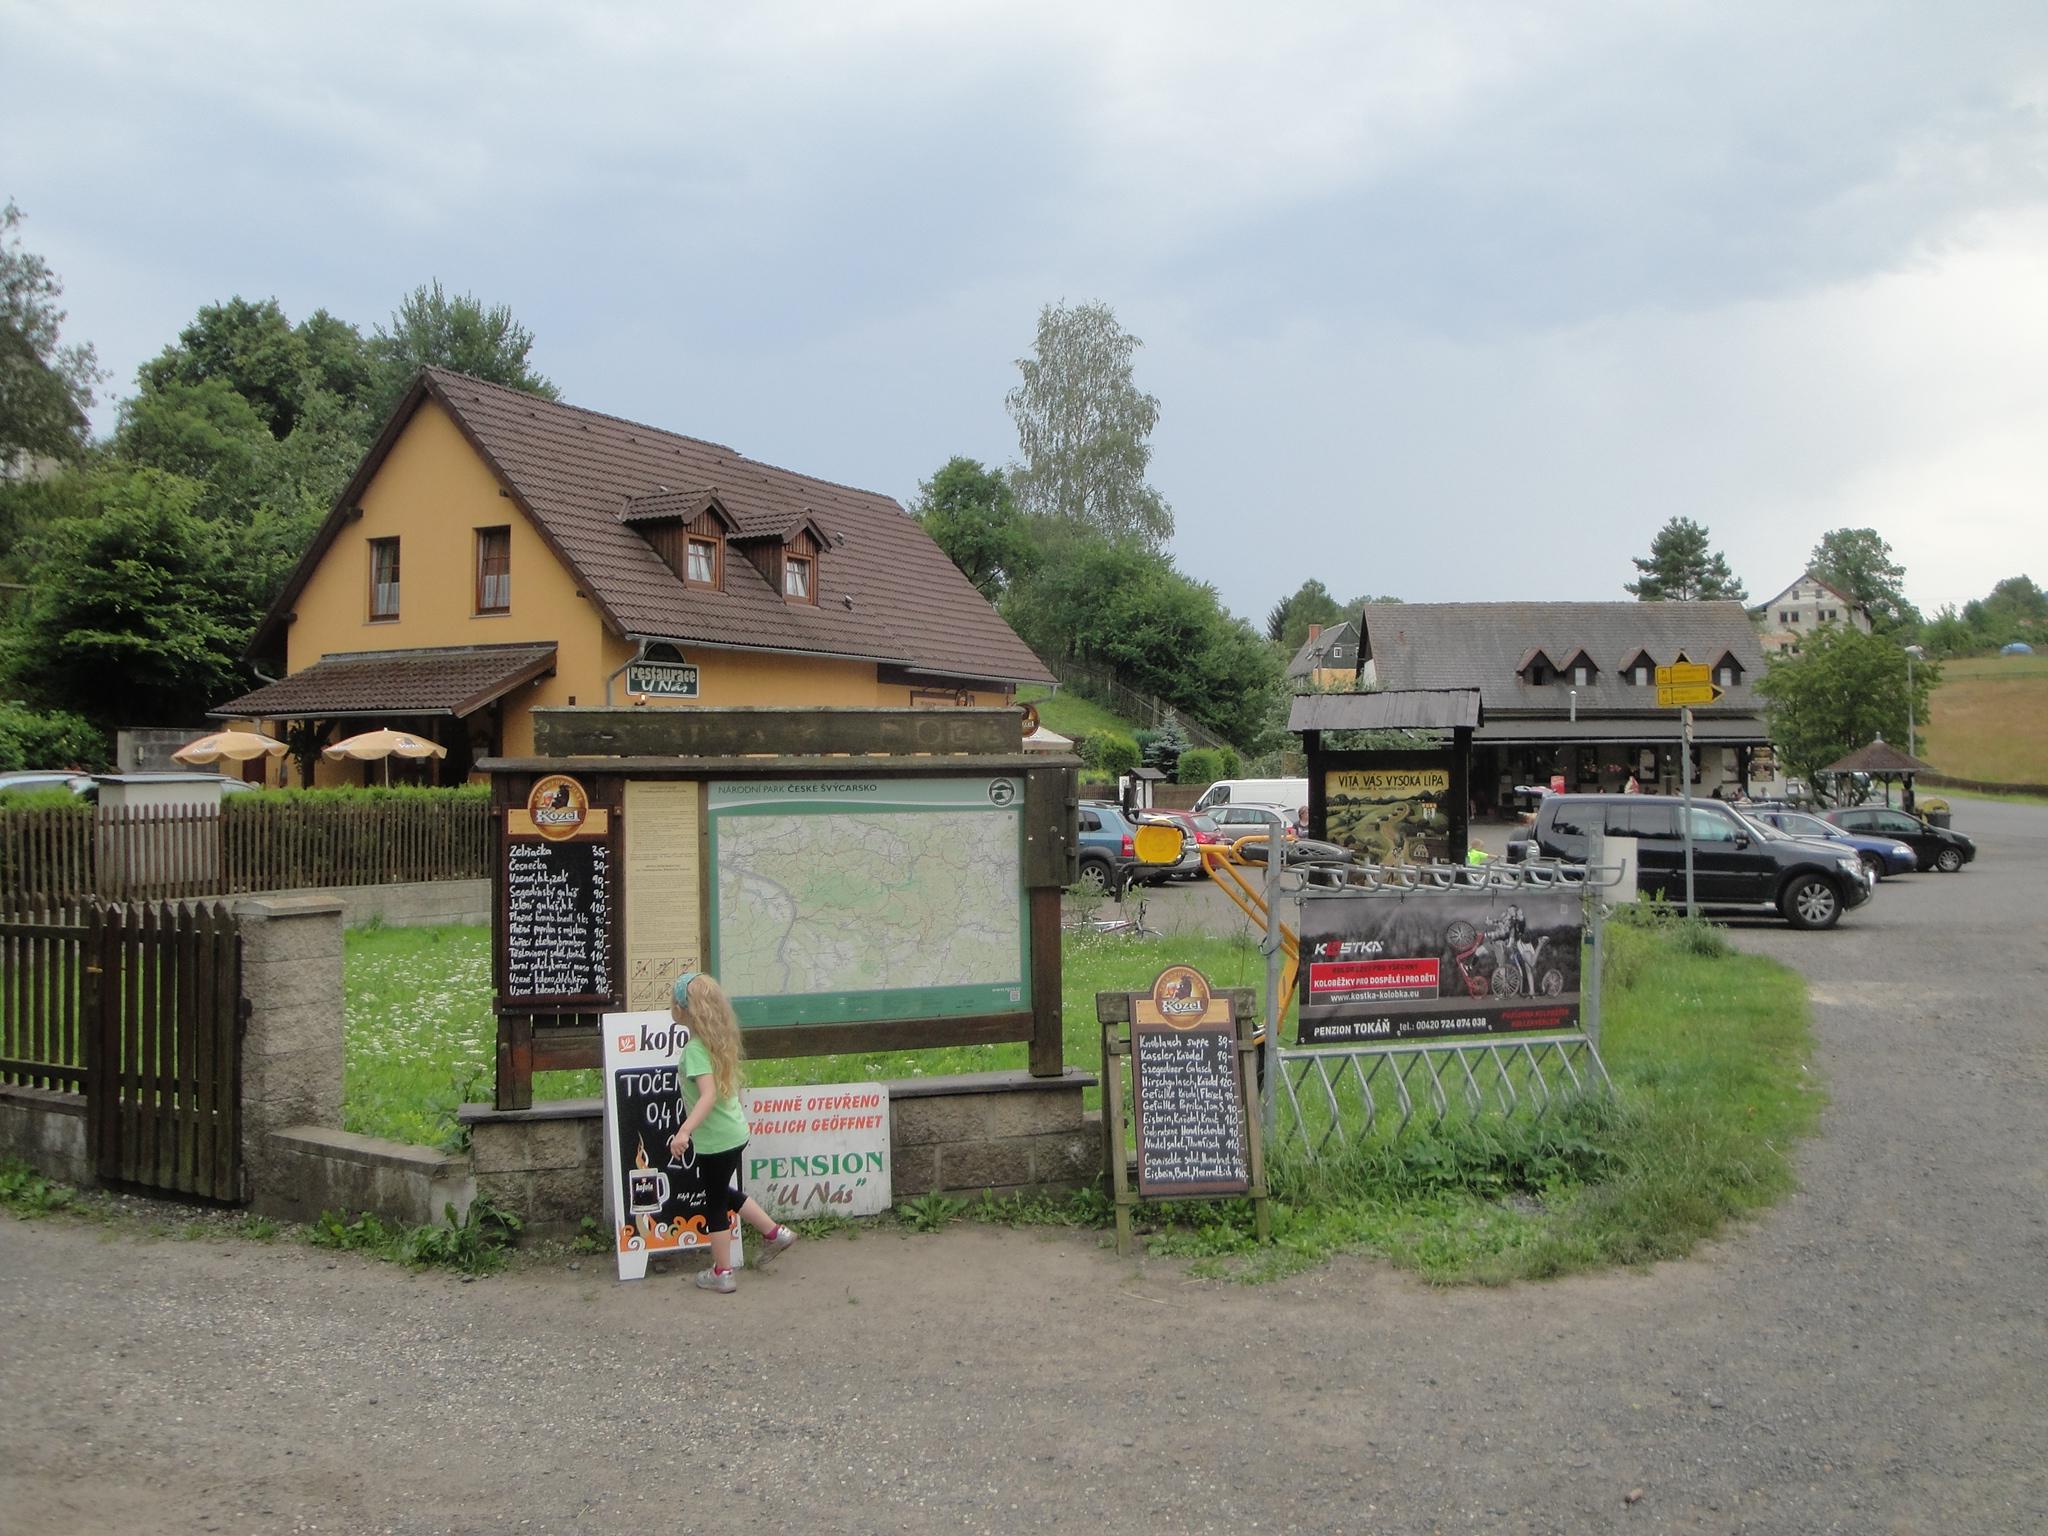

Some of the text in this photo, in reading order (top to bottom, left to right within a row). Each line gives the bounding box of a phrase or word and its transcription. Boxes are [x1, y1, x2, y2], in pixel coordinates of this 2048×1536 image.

[631, 666, 696, 683] restaurace
[641, 679, 688, 693] U Nás
[718, 783, 877, 794] NÁRODNÍ PARK ČESKÉ ŠVÝCARSKO
[536, 809, 581, 823] Kozel
[508, 857, 548, 871] Česnečka
[509, 897, 535, 910] Jelení
[1314, 940, 1384, 958] KOSTKA
[1314, 976, 1356, 988] KOLOBĚŽKY
[1356, 976, 1369, 986] PRO
[1369, 974, 1401, 984] DOSPĚLÉ
[1405, 974, 1420, 983] PRO
[1420, 972, 1436, 983] DĚTI
[1330, 990, 1420, 1003] www.kostka-kolobka.eu
[1162, 1000, 1204, 1013] Kozel
[1314, 1024, 1352, 1037] PENZION
[1354, 1018, 1391, 1035] TOKÁŇ
[1416, 1020, 1440, 1031] 00420
[1440, 1019, 1455, 1029] 724
[1456, 1018, 1471, 1028] 074
[1139, 1034, 1182, 1048] Knoblauch
[1186, 1038, 1209, 1048] suppe
[753, 1092, 880, 1114] DENNĚ OTEVŘENO
[646, 1102, 671, 1130] 0,4
[748, 1114, 883, 1135] TÄGLICH GEÖFFNET
[750, 1151, 884, 1180] PENSION
